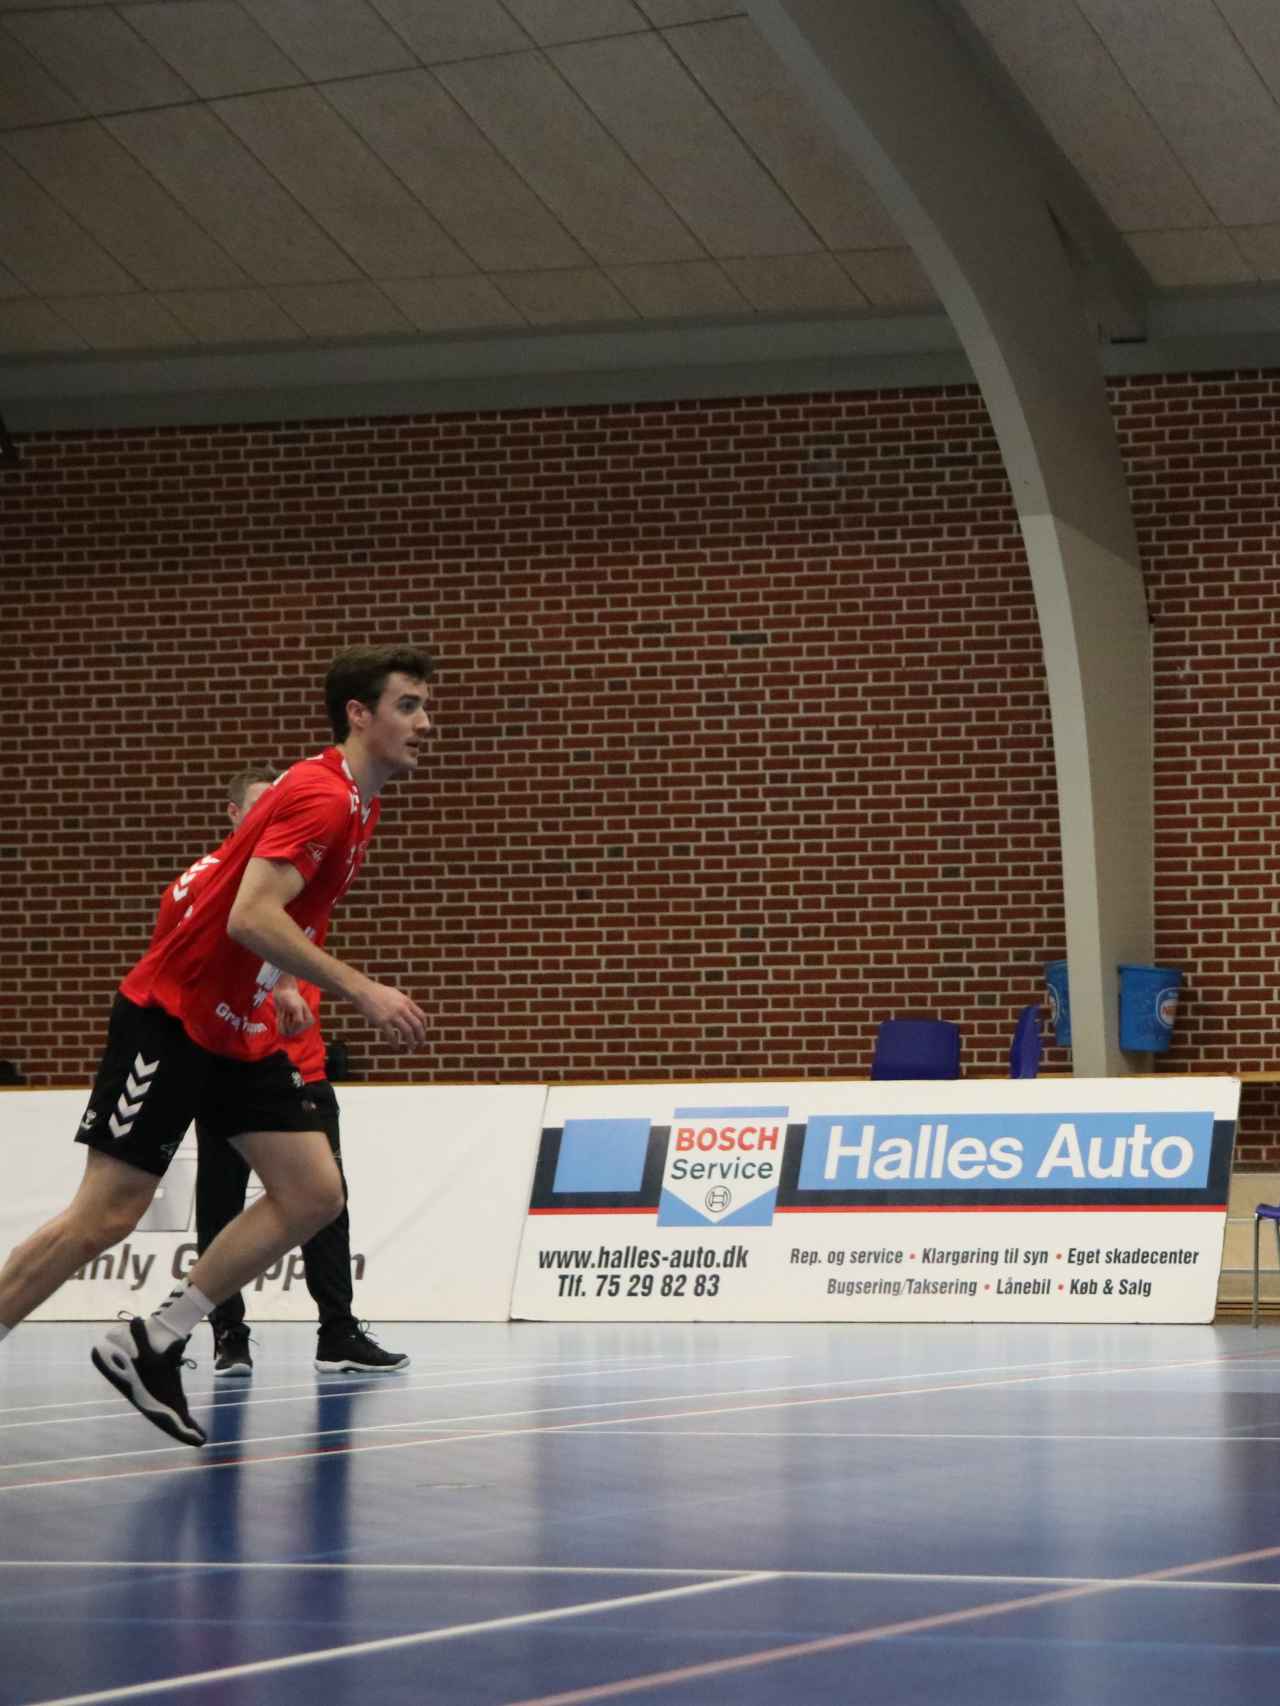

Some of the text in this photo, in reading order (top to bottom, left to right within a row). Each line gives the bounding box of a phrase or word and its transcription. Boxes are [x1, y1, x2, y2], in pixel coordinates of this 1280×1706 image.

[675, 1126, 780, 1151] BOSCH
[823, 1122, 1194, 1181] Halles Auto
[671, 1156, 773, 1180] Service
[538, 1246, 749, 1269] www.halles-auto.dk
[790, 1247, 1199, 1266] Rep. og service Klargøring til syn Eget skadecenter
[558, 1274, 720, 1297] Tlf. 75 29 82 83
[996, 1276, 1051, 1296] Lånebil
[1069, 1278, 1098, 1296] Køb
[1102, 1278, 1114, 1296] &
[1119, 1278, 1152, 1298] Salg
